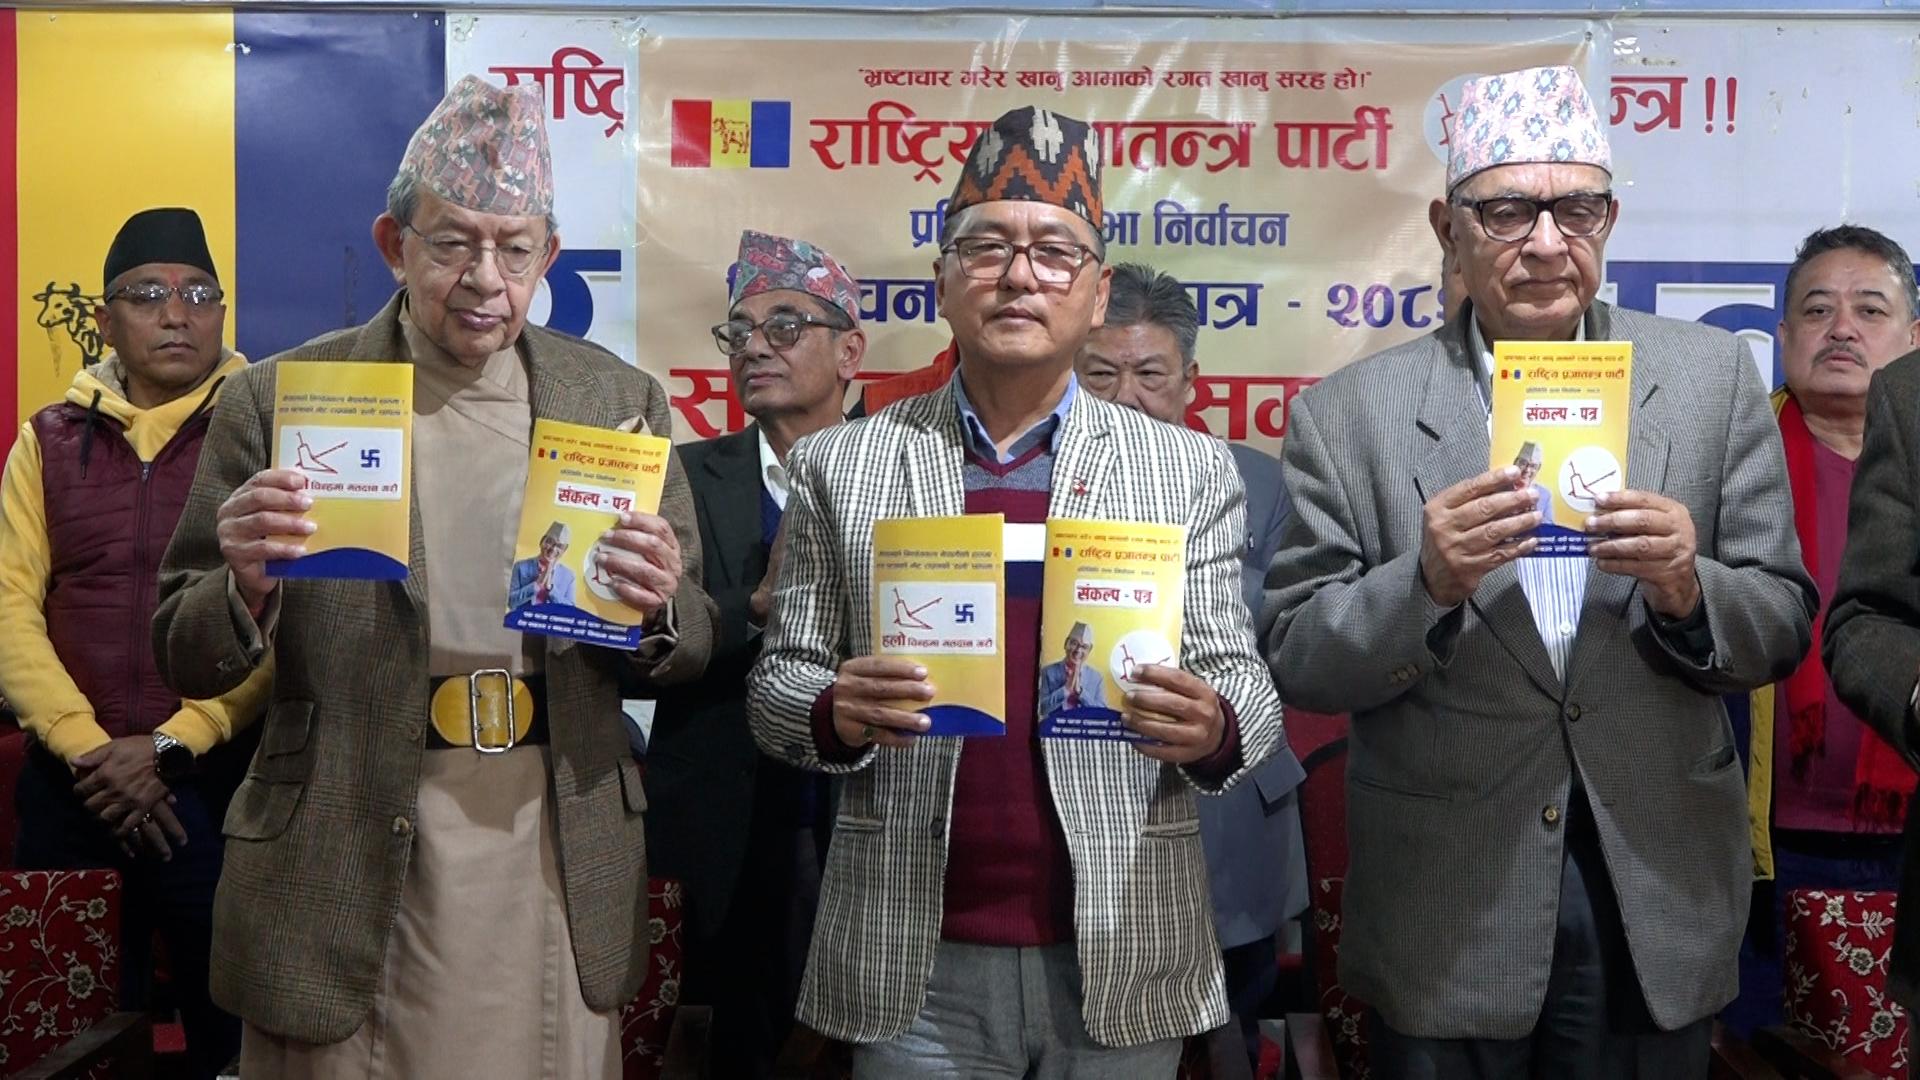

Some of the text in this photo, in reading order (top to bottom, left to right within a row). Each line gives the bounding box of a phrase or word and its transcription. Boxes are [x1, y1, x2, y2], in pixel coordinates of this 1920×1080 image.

[960, 66, 1009, 88] गरेर
[1016, 70, 1066, 91] खानु
[1072, 66, 1153, 88] आमाको
[1163, 71, 1212, 88] रगत
[1219, 71, 1269, 91] खानु
[1276, 71, 1327, 89] सरह
[1274, 105, 1393, 170] पार्टी
[1153, 199, 1290, 246] निर्वाचन
[1326, 283, 1446, 328] २०८
[1525, 403, 1568, 421] संकल्प
[1580, 407, 1599, 421] पत्र
[558, 485, 601, 507] संकल्प
[612, 496, 632, 512] पत्र
[1077, 583, 1120, 602] संकल्प
[1134, 589, 1153, 604] पत्र
